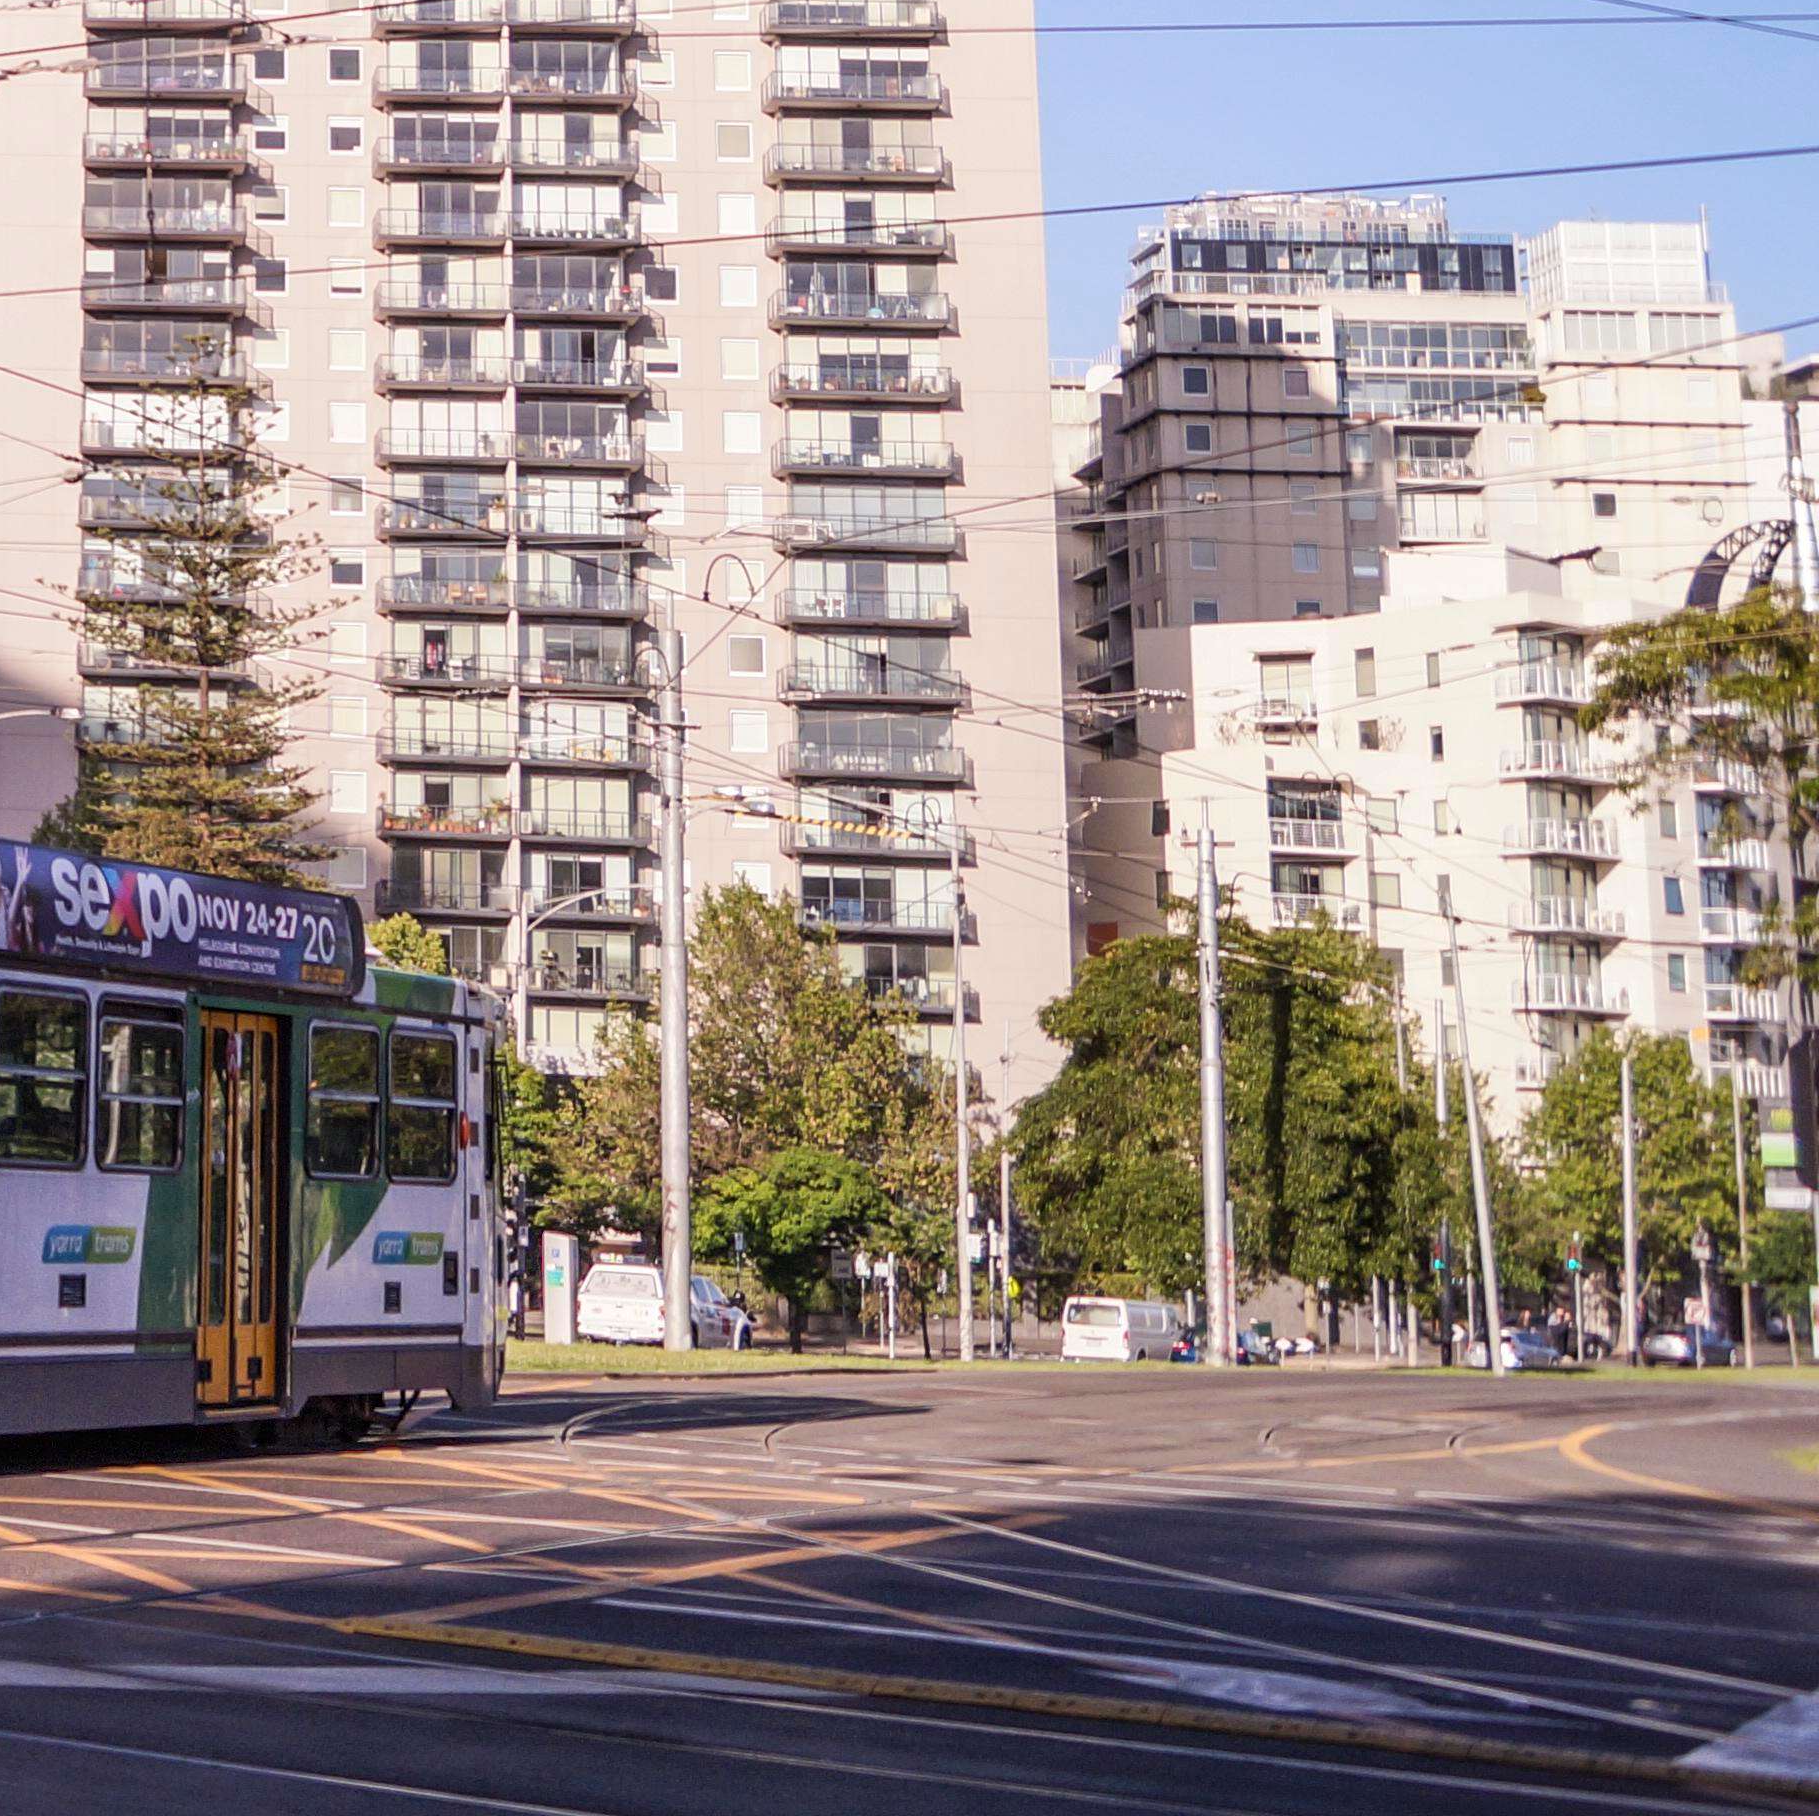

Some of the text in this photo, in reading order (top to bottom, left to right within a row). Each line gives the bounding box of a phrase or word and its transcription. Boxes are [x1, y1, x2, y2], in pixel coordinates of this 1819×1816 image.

[51, 857, 197, 959] sexpo
[197, 894, 297, 940] NOV 24-27
[303, 914, 336, 964] 20
[49, 1232, 130, 1259] yarra trams
[377, 1237, 439, 1259] yarra trams
